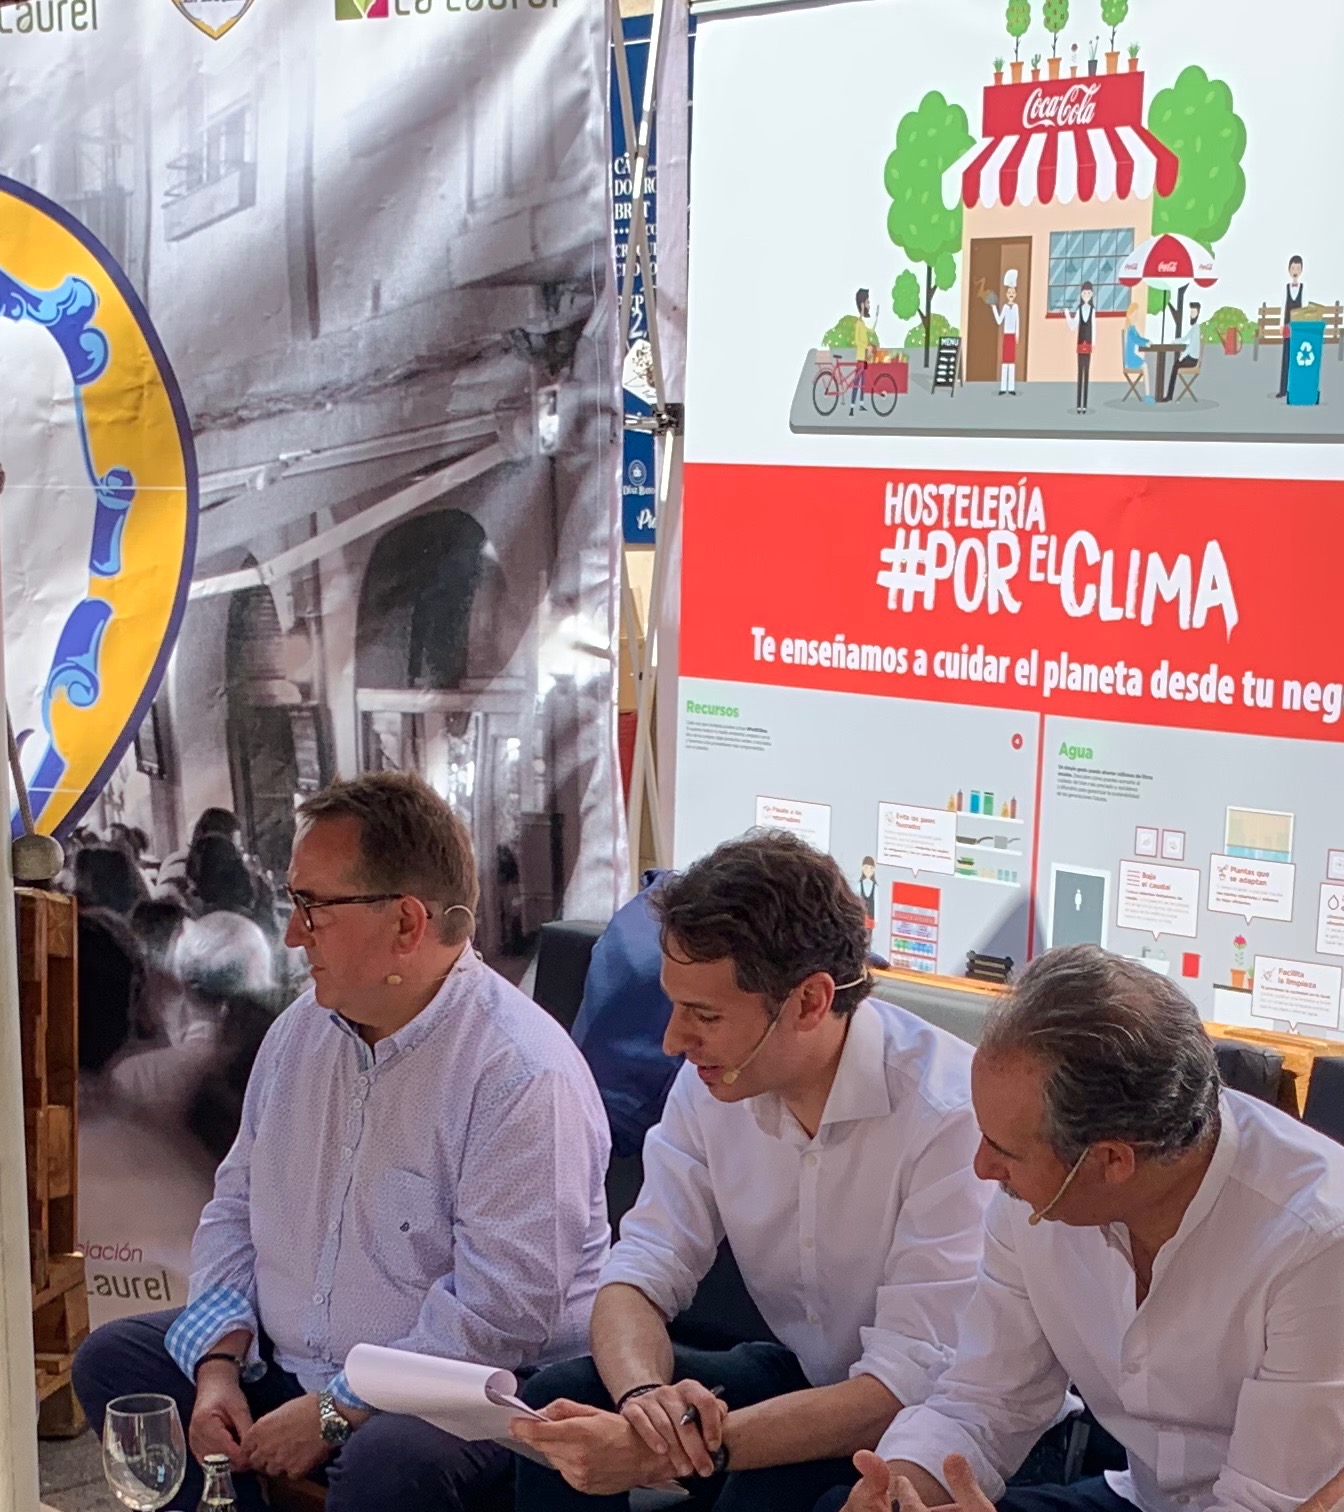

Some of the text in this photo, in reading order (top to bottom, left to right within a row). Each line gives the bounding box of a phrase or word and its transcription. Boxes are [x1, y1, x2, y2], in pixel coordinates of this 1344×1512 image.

[1022, 83, 1100, 128] Coca-Cola
[614, 202, 650, 220] BRT
[884, 476, 1045, 534] HOSTELERÍA
[876, 529, 1240, 644] #POR EL CLIMA
[751, 626, 775, 662] Te
[781, 633, 909, 680] enseñamos
[913, 652, 927, 678] a
[933, 644, 1011, 685] cuidar
[1015, 654, 1039, 688] el
[1043, 654, 1143, 699] planeta
[1150, 659, 1235, 706] desde
[1242, 671, 1275, 709] tu
[686, 699, 739, 718] Recursos
[1058, 741, 1094, 760] Agua
[1230, 865, 1255, 877] Plantas
[1239, 877, 1267, 887] adaptan
[1278, 968, 1305, 978] Facilita
[1286, 979, 1317, 989] limpieza
